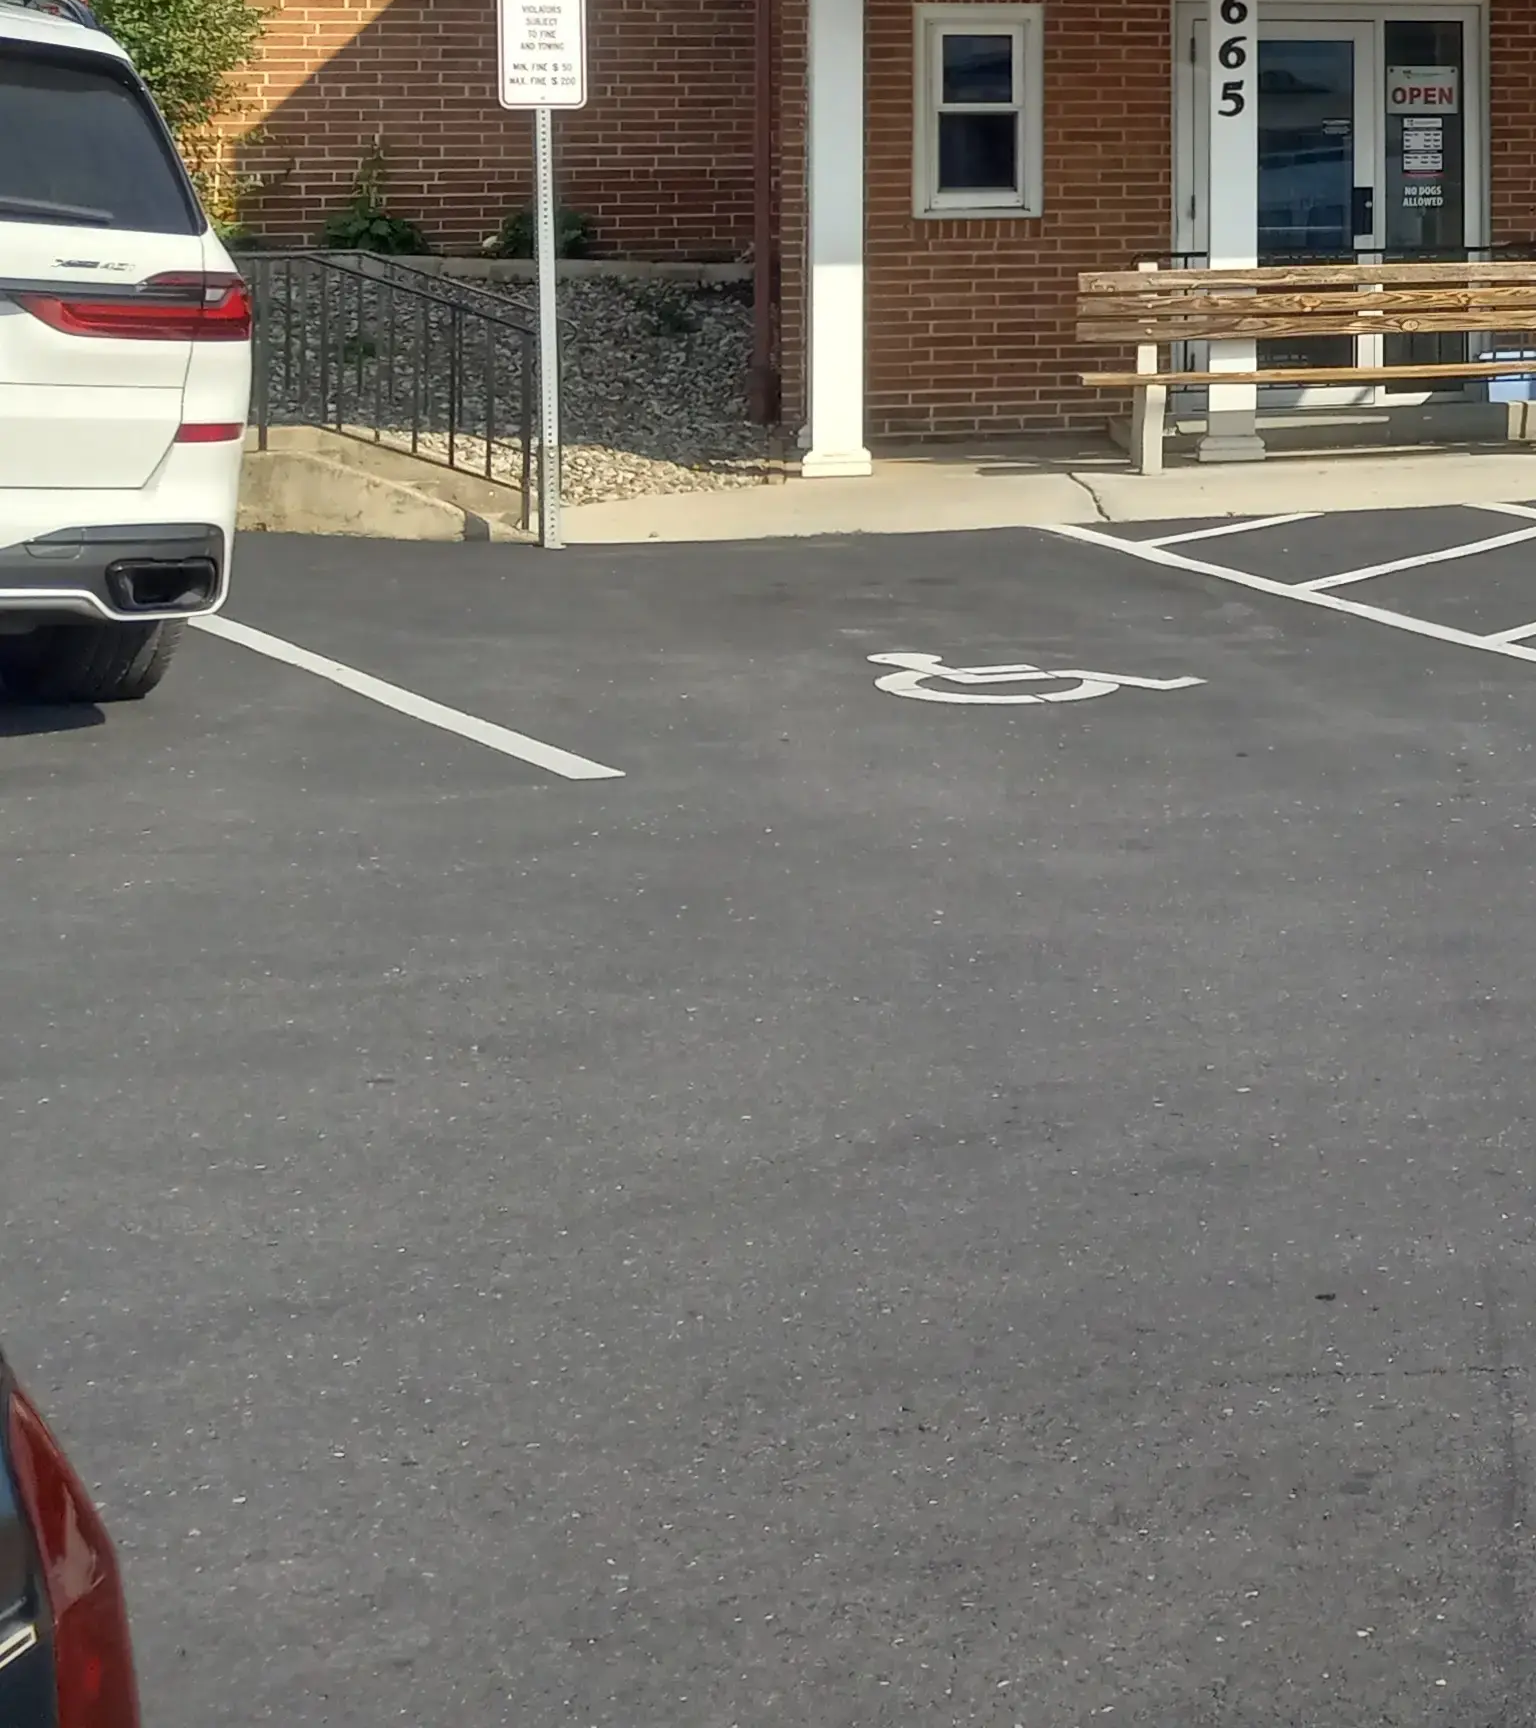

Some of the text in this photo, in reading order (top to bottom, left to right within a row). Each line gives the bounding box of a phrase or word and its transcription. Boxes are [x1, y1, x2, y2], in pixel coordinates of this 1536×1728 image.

[1392, 86, 1454, 105] OPEN
[1404, 185, 1442, 196] NO DOGS
[1402, 197, 1444, 207] ALLOWED
